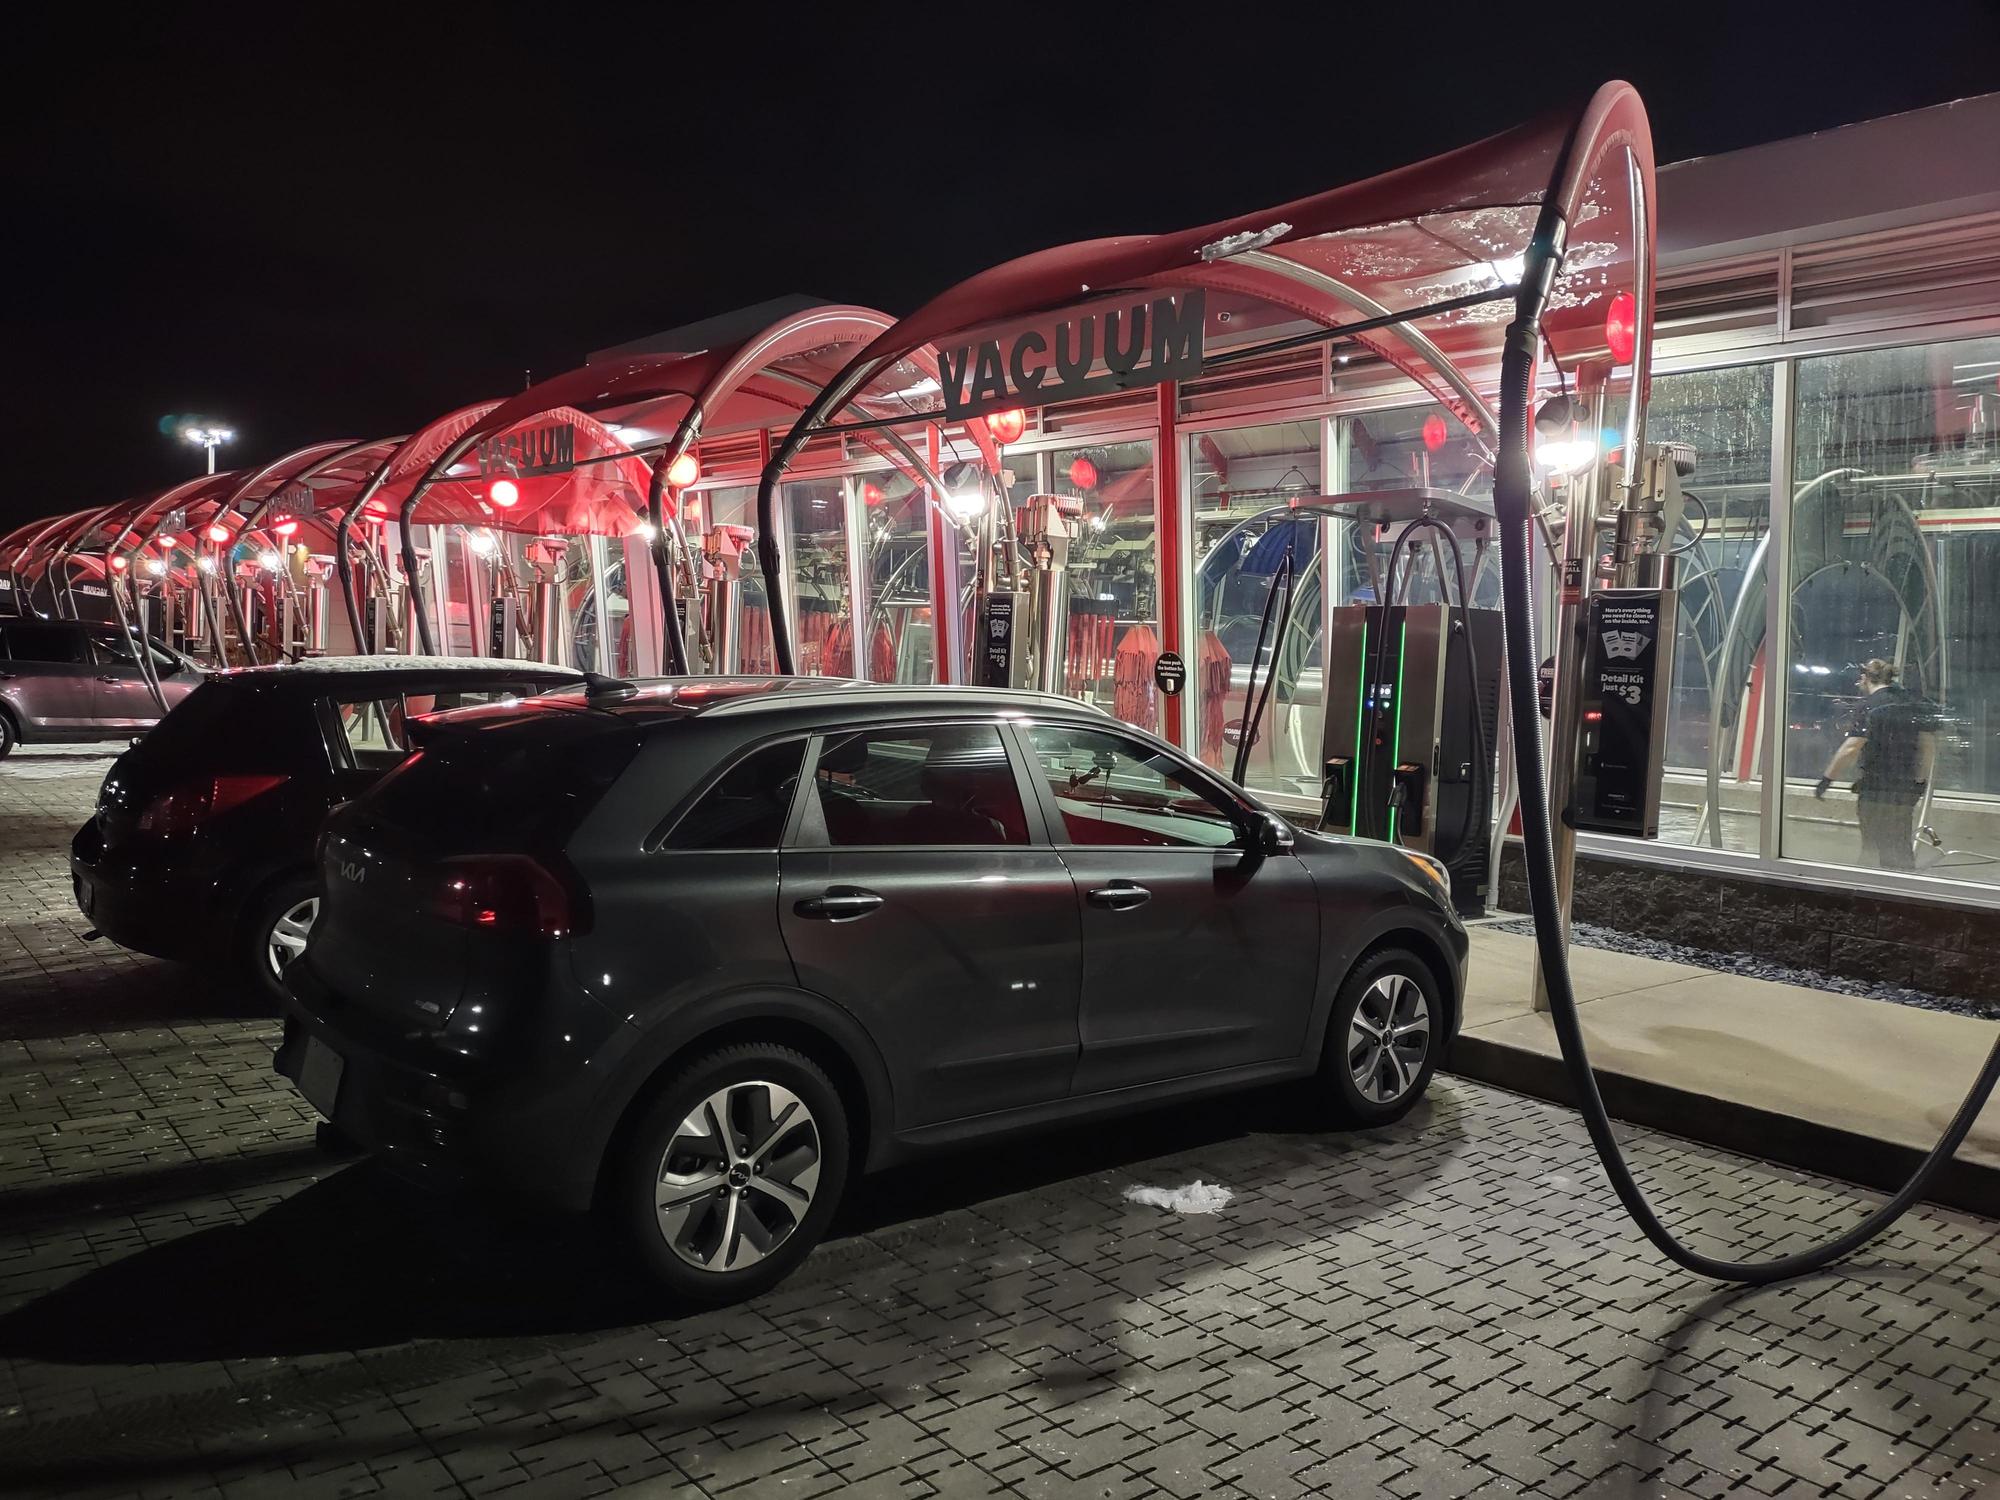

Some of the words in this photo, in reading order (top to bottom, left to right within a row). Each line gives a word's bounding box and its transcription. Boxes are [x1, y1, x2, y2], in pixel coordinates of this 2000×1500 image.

[937, 288, 1206, 420] VACUUM
[1601, 673, 1628, 683] Detail
[1629, 674, 1644, 684] Kit
[1619, 685, 1641, 705] $3
